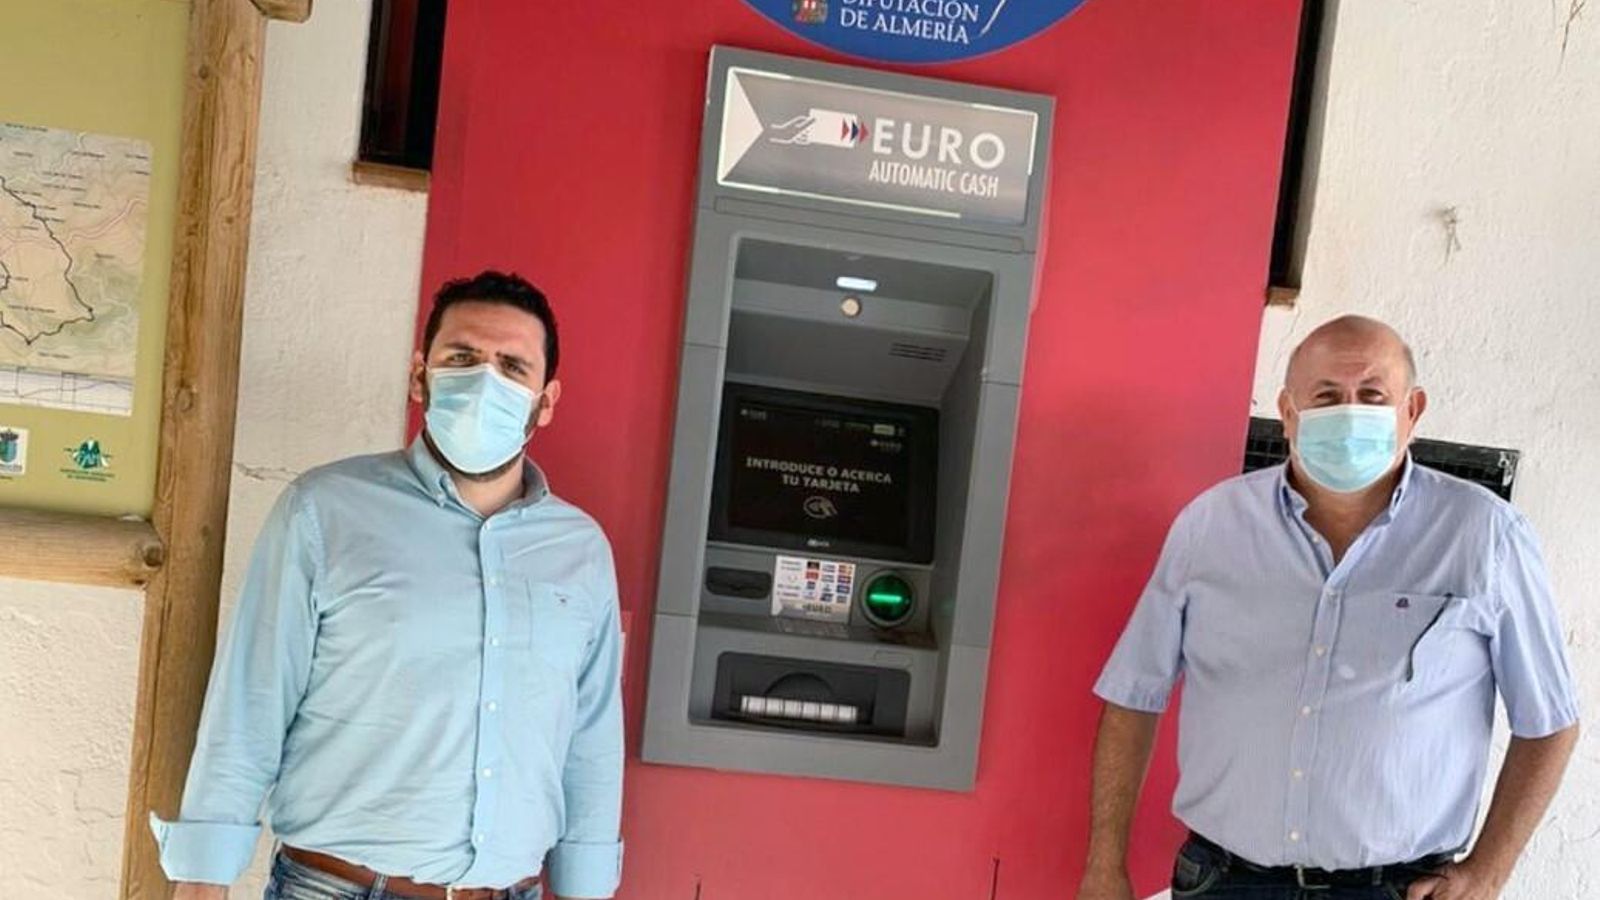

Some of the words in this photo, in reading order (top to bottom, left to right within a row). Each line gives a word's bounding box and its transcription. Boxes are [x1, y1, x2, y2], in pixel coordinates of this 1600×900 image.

[840, 8, 868, 29] DE
[872, 13, 969, 44] ALMERÍA
[873, 117, 1005, 169] EURO
[868, 160, 957, 192] AUTOMATIC
[960, 172, 999, 197] CASH
[746, 457, 824, 477] INTRODUCE
[827, 467, 838, 477] O
[840, 468, 892, 484] ACERCA
[782, 474, 799, 487] TU
[803, 476, 860, 493] TARJETA
